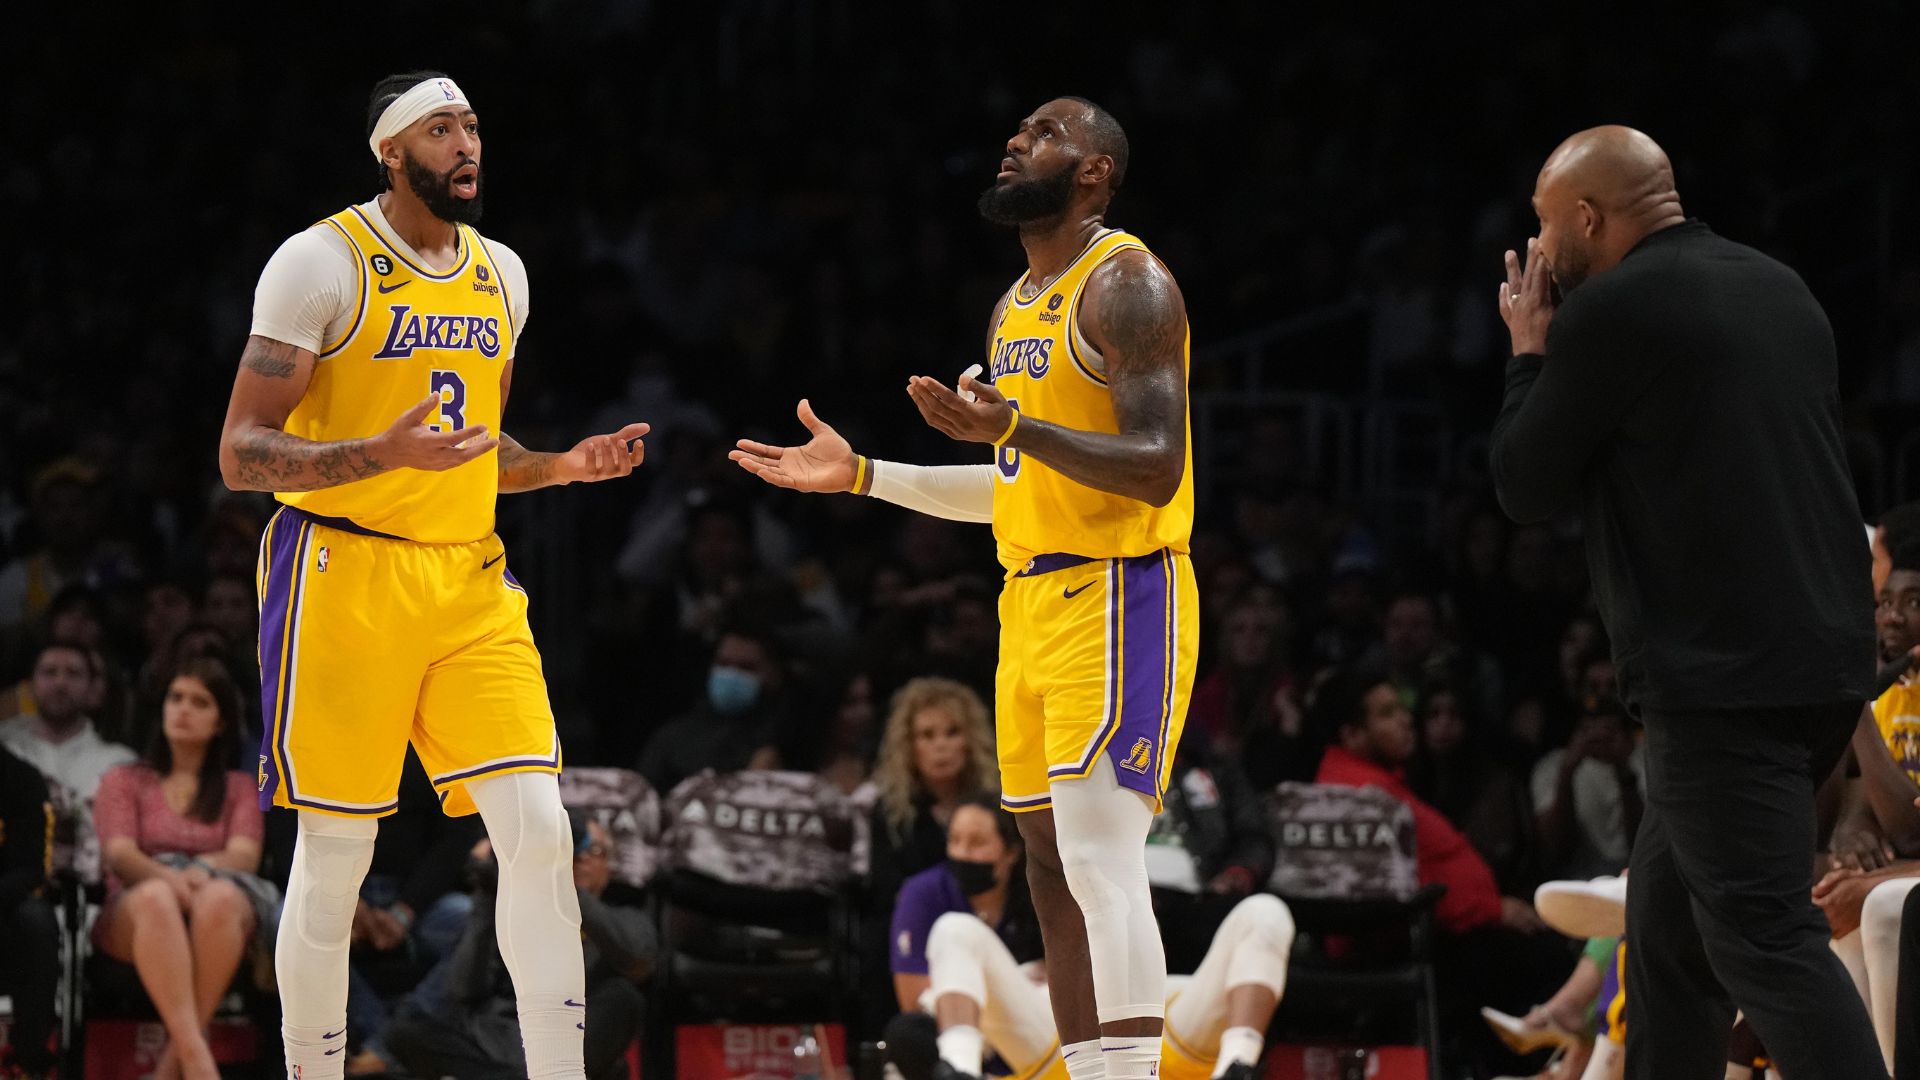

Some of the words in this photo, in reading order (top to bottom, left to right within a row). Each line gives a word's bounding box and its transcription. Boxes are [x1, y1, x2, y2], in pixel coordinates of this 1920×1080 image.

[374, 257, 389, 274] 6
[473, 282, 499, 296] bibigo
[1039, 311, 1061, 325] bibigo
[372, 304, 501, 359] LAKERS
[429, 370, 466, 437] 3
[714, 802, 826, 837] DELTA
[1283, 822, 1397, 848] DELTA
